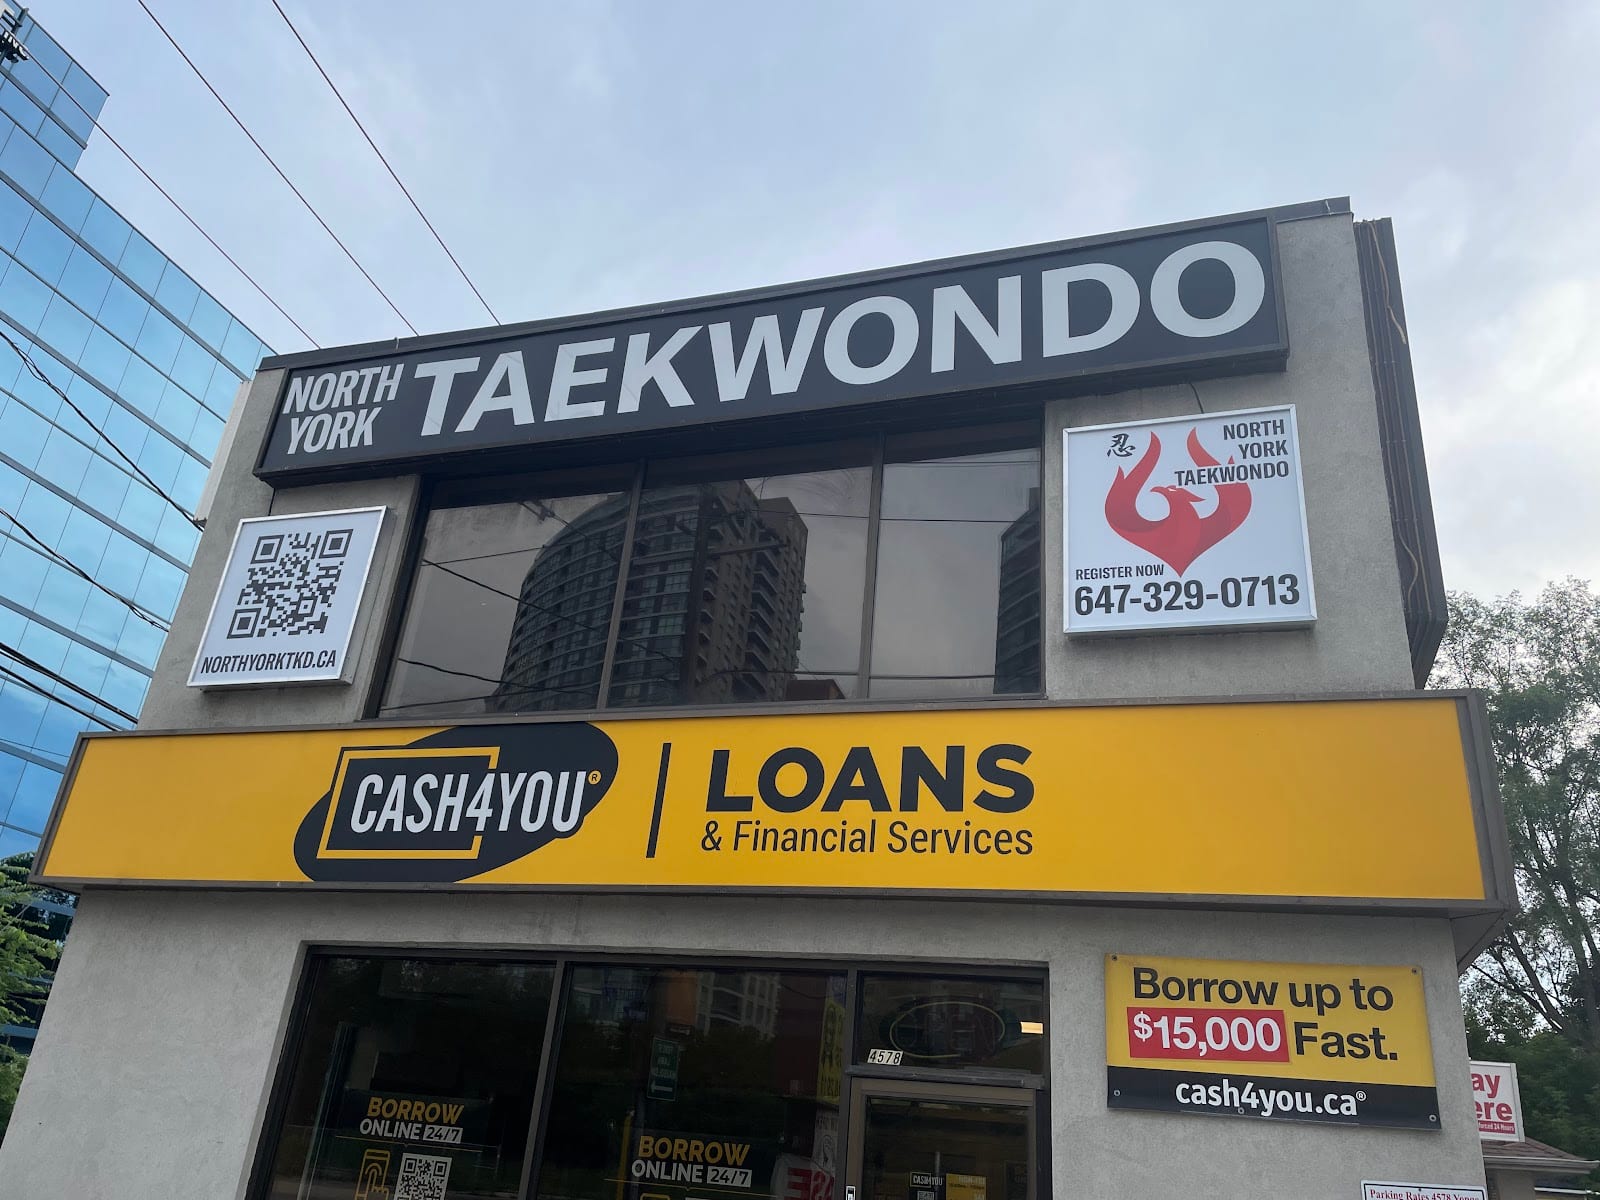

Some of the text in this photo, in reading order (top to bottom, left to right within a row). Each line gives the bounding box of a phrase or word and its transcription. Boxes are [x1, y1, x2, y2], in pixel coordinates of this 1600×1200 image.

[414, 240, 1266, 436] TAEKWONDO
[282, 363, 404, 415] NORTH
[286, 407, 382, 455] YORK
[1223, 419, 1285, 441] NORTH
[1238, 439, 1288, 460] YORK
[1174, 460, 1289, 487] TAEKWONDO
[1075, 564, 1165, 580] REGISTER NOW
[1074, 573, 1300, 616] 647-329-0713
[200, 650, 337, 674] NORTHYORKTKD.CA
[705, 743, 1035, 814] LOANS
[701, 819, 1034, 855] & Financial Services
[1133, 967, 1394, 1016] Borrow up to
[1133, 1011, 1399, 1061] $15,000 Fast.
[869, 1050, 901, 1065] 4578
[1471, 1073, 1501, 1098] ay
[367, 1096, 465, 1125] BORROW
[1475, 1101, 1513, 1121] ere
[359, 1118, 461, 1143] ONLINE 24/7
[638, 1135, 751, 1166] BORROW
[631, 1159, 750, 1186] ONLINE 24/7
[1370, 1189, 1404, 1200] Parking
[1406, 1191, 1429, 1200] Rates
